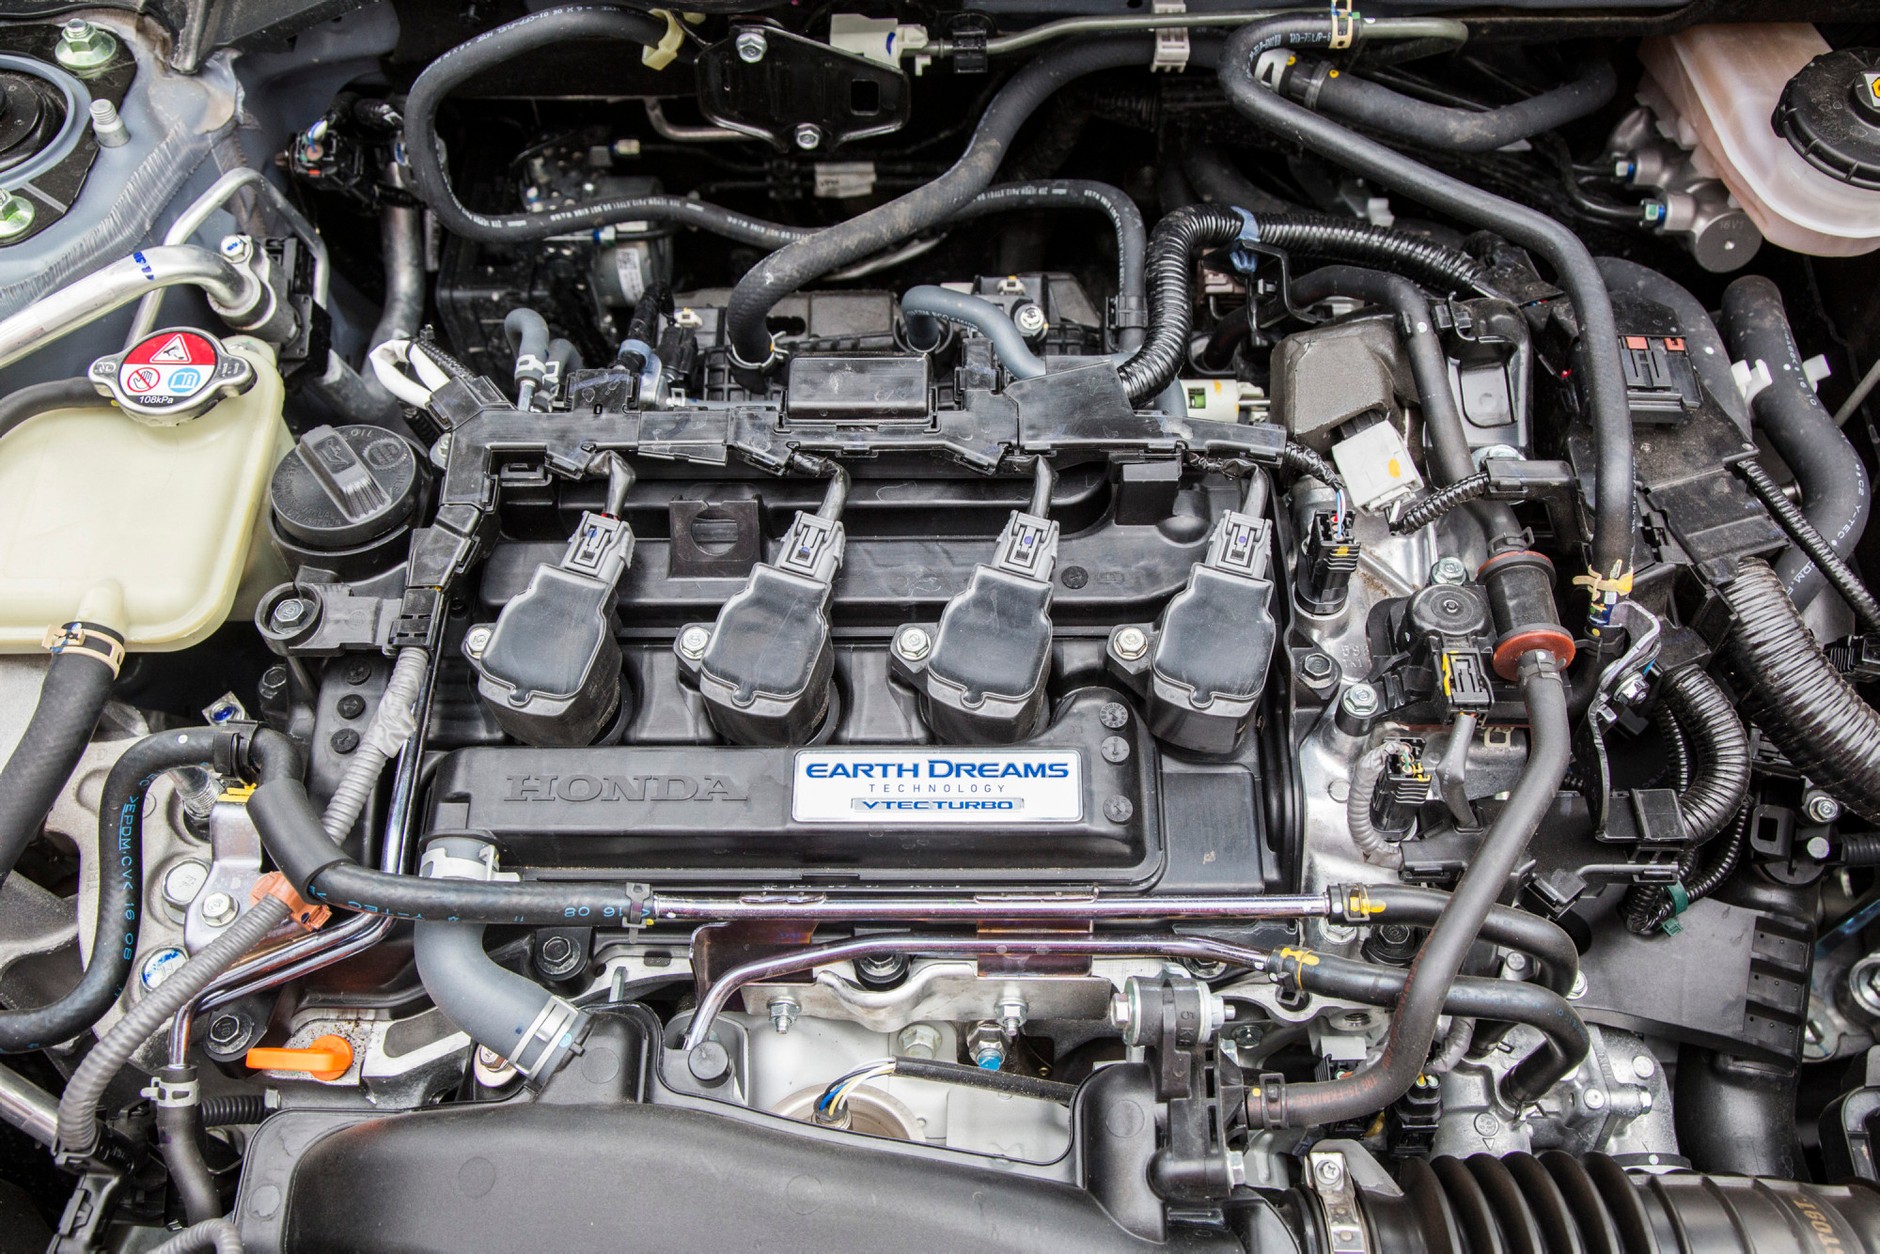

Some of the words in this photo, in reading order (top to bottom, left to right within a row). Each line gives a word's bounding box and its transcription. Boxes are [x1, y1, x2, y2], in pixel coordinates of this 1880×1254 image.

[139, 395, 174, 404] 108kPa
[1837, 504, 1862, 540] Y-TEC
[806, 763, 919, 778] EARTH
[928, 759, 1069, 778] DREAMS
[503, 774, 749, 802] HONDA
[869, 784, 1005, 793] TECHNOLOGY
[124, 902, 135, 920] 16
[564, 906, 590, 917] 08
[603, 906, 623, 917] 16
[123, 933, 134, 960] 08
